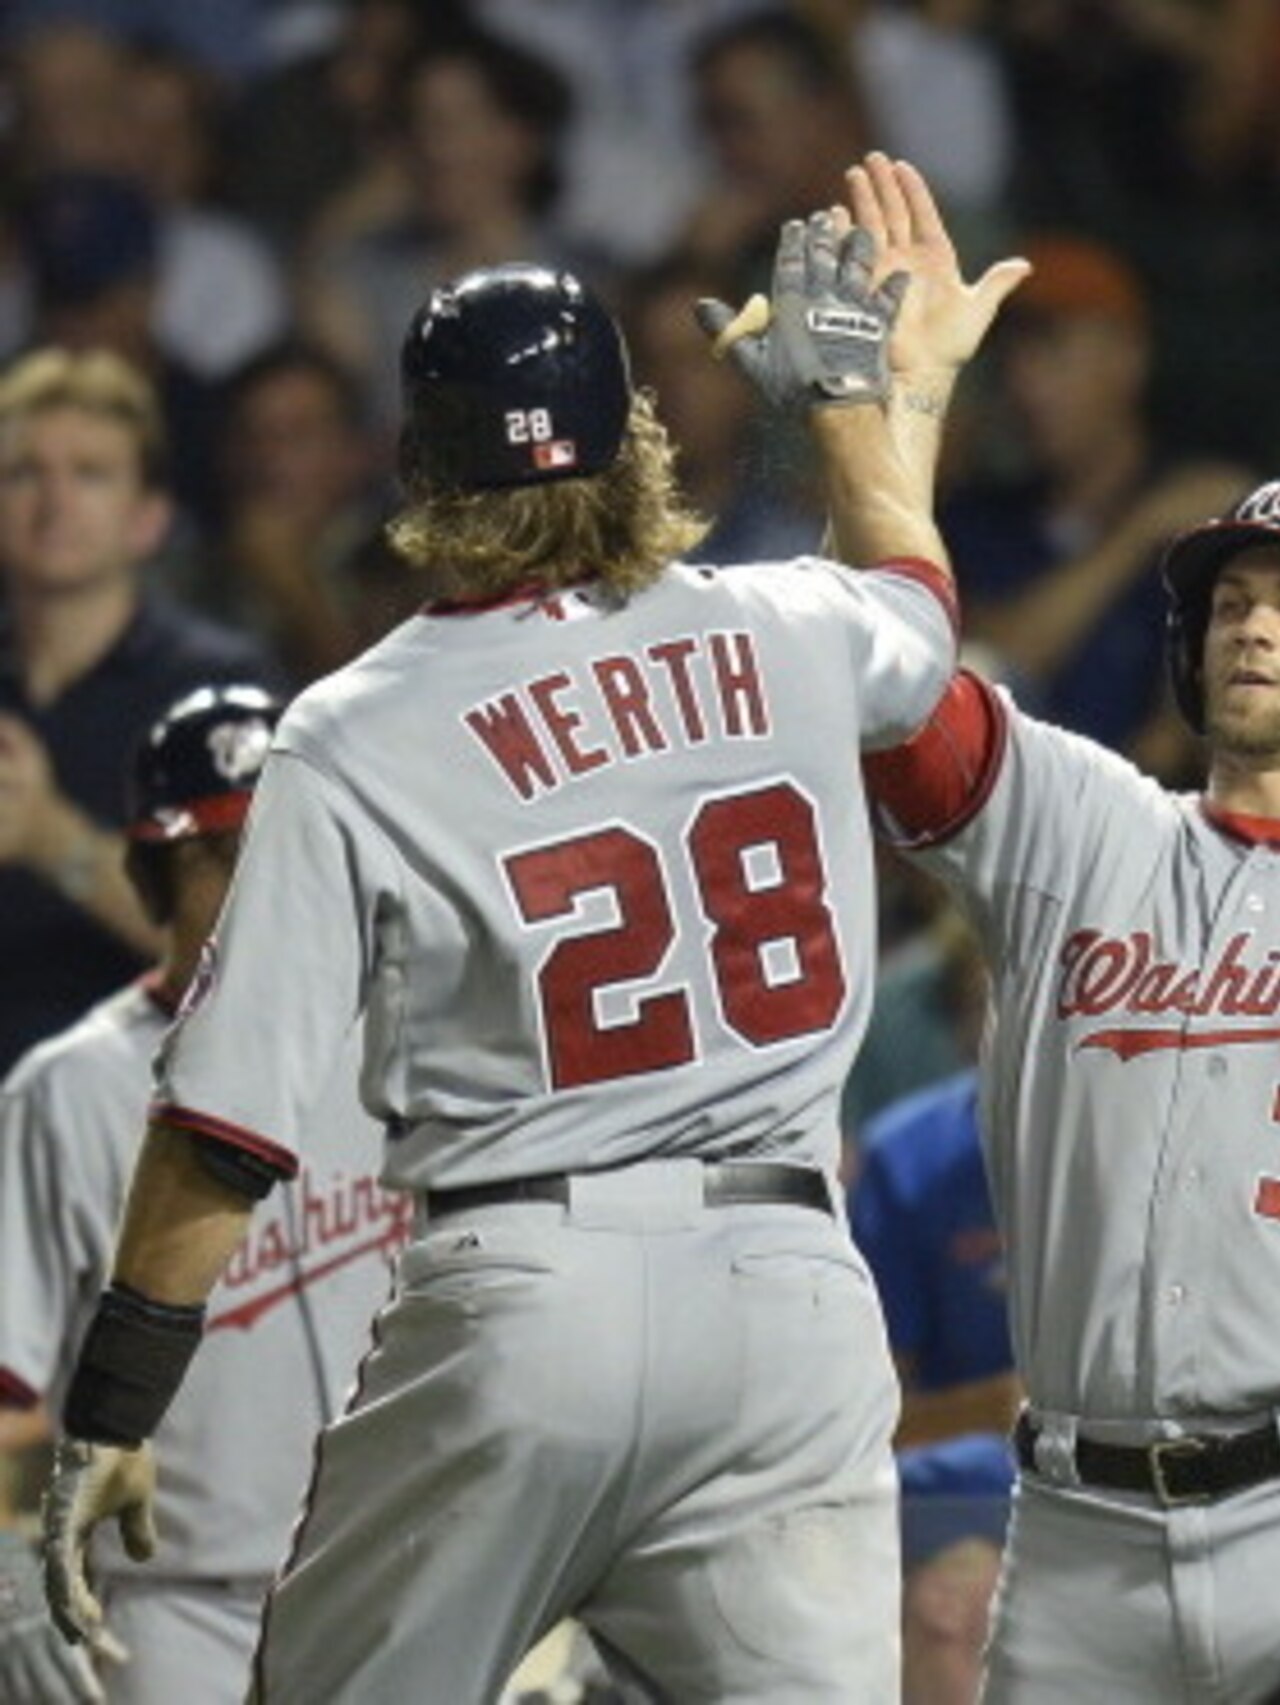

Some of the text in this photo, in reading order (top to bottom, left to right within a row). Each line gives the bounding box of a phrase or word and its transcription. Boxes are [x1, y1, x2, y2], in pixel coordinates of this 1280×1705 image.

[504, 408, 553, 445] 28
[460, 629, 771, 805] WERTH
[497, 773, 850, 1094] 28
